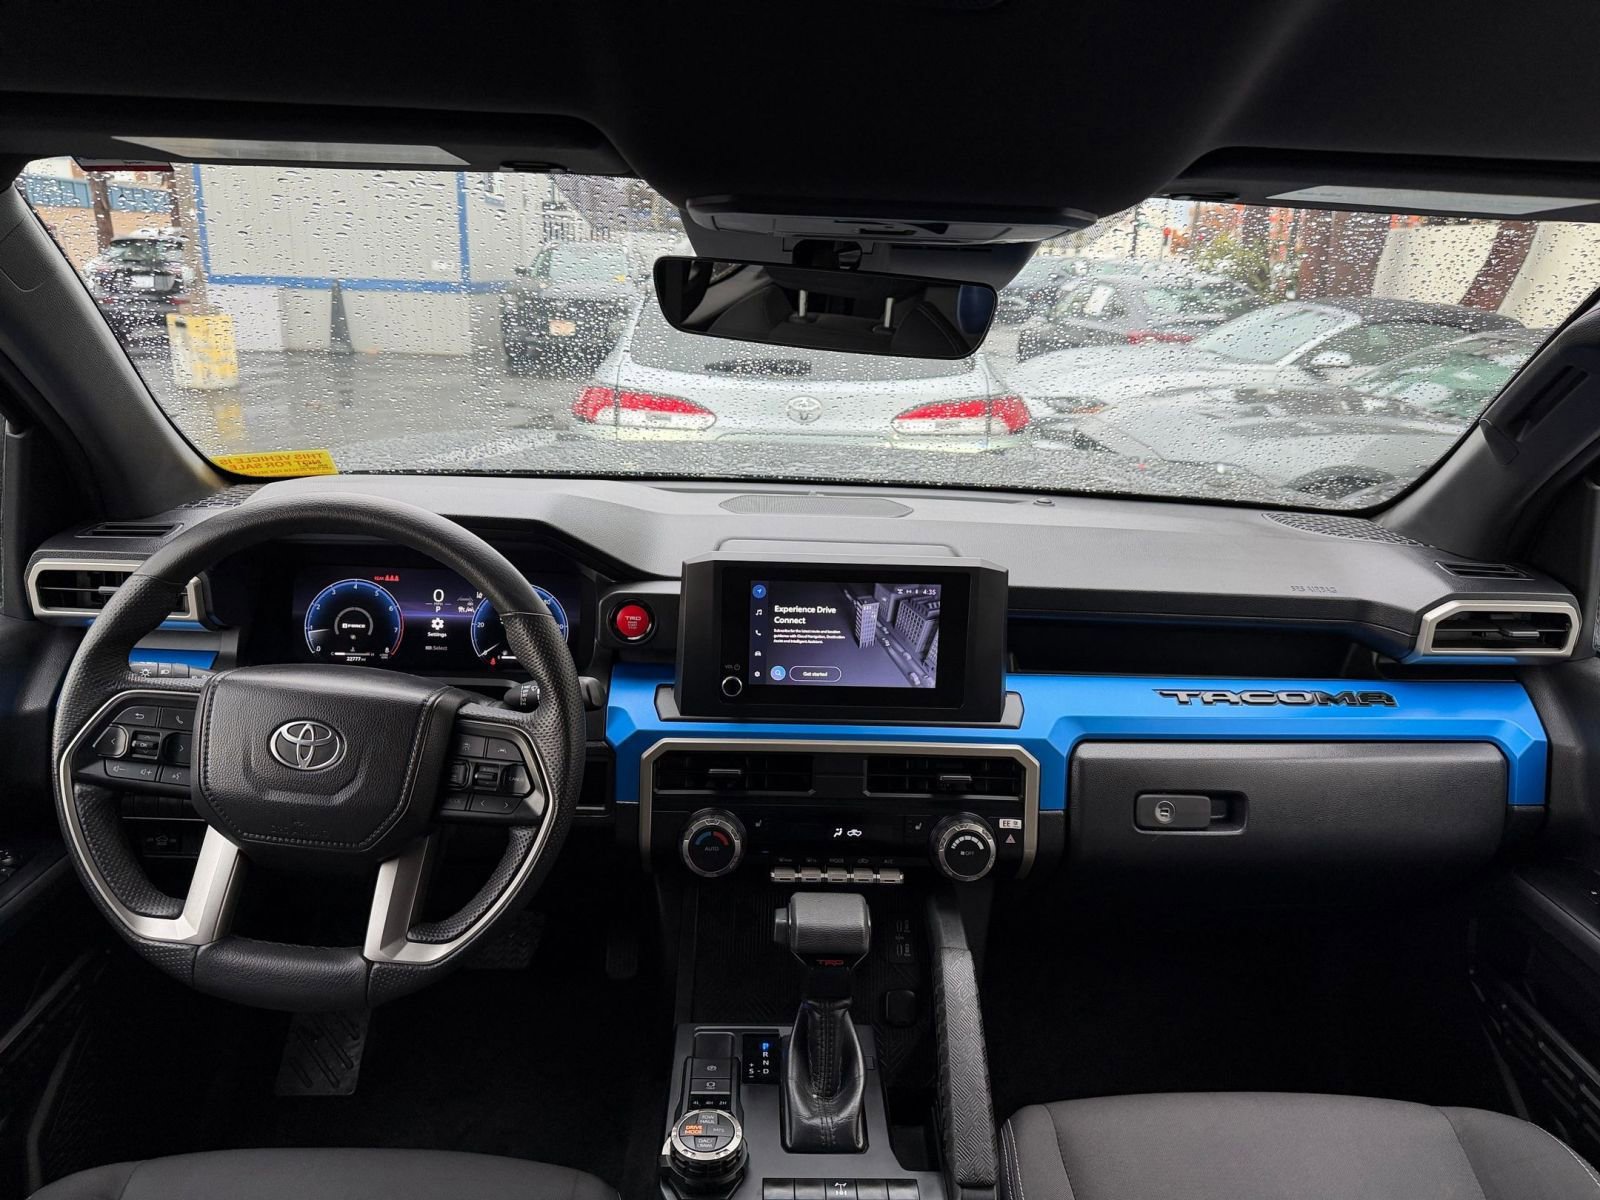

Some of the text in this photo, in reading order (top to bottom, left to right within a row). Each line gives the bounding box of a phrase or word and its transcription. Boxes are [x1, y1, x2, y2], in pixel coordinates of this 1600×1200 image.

[433, 589, 445, 603] 0
[774, 605, 837, 614] Experience Drive
[773, 616, 806, 625] Connect
[427, 631, 447, 639] Settings
[1152, 688, 1400, 708] TACOMA
[816, 959, 844, 967] TRD
